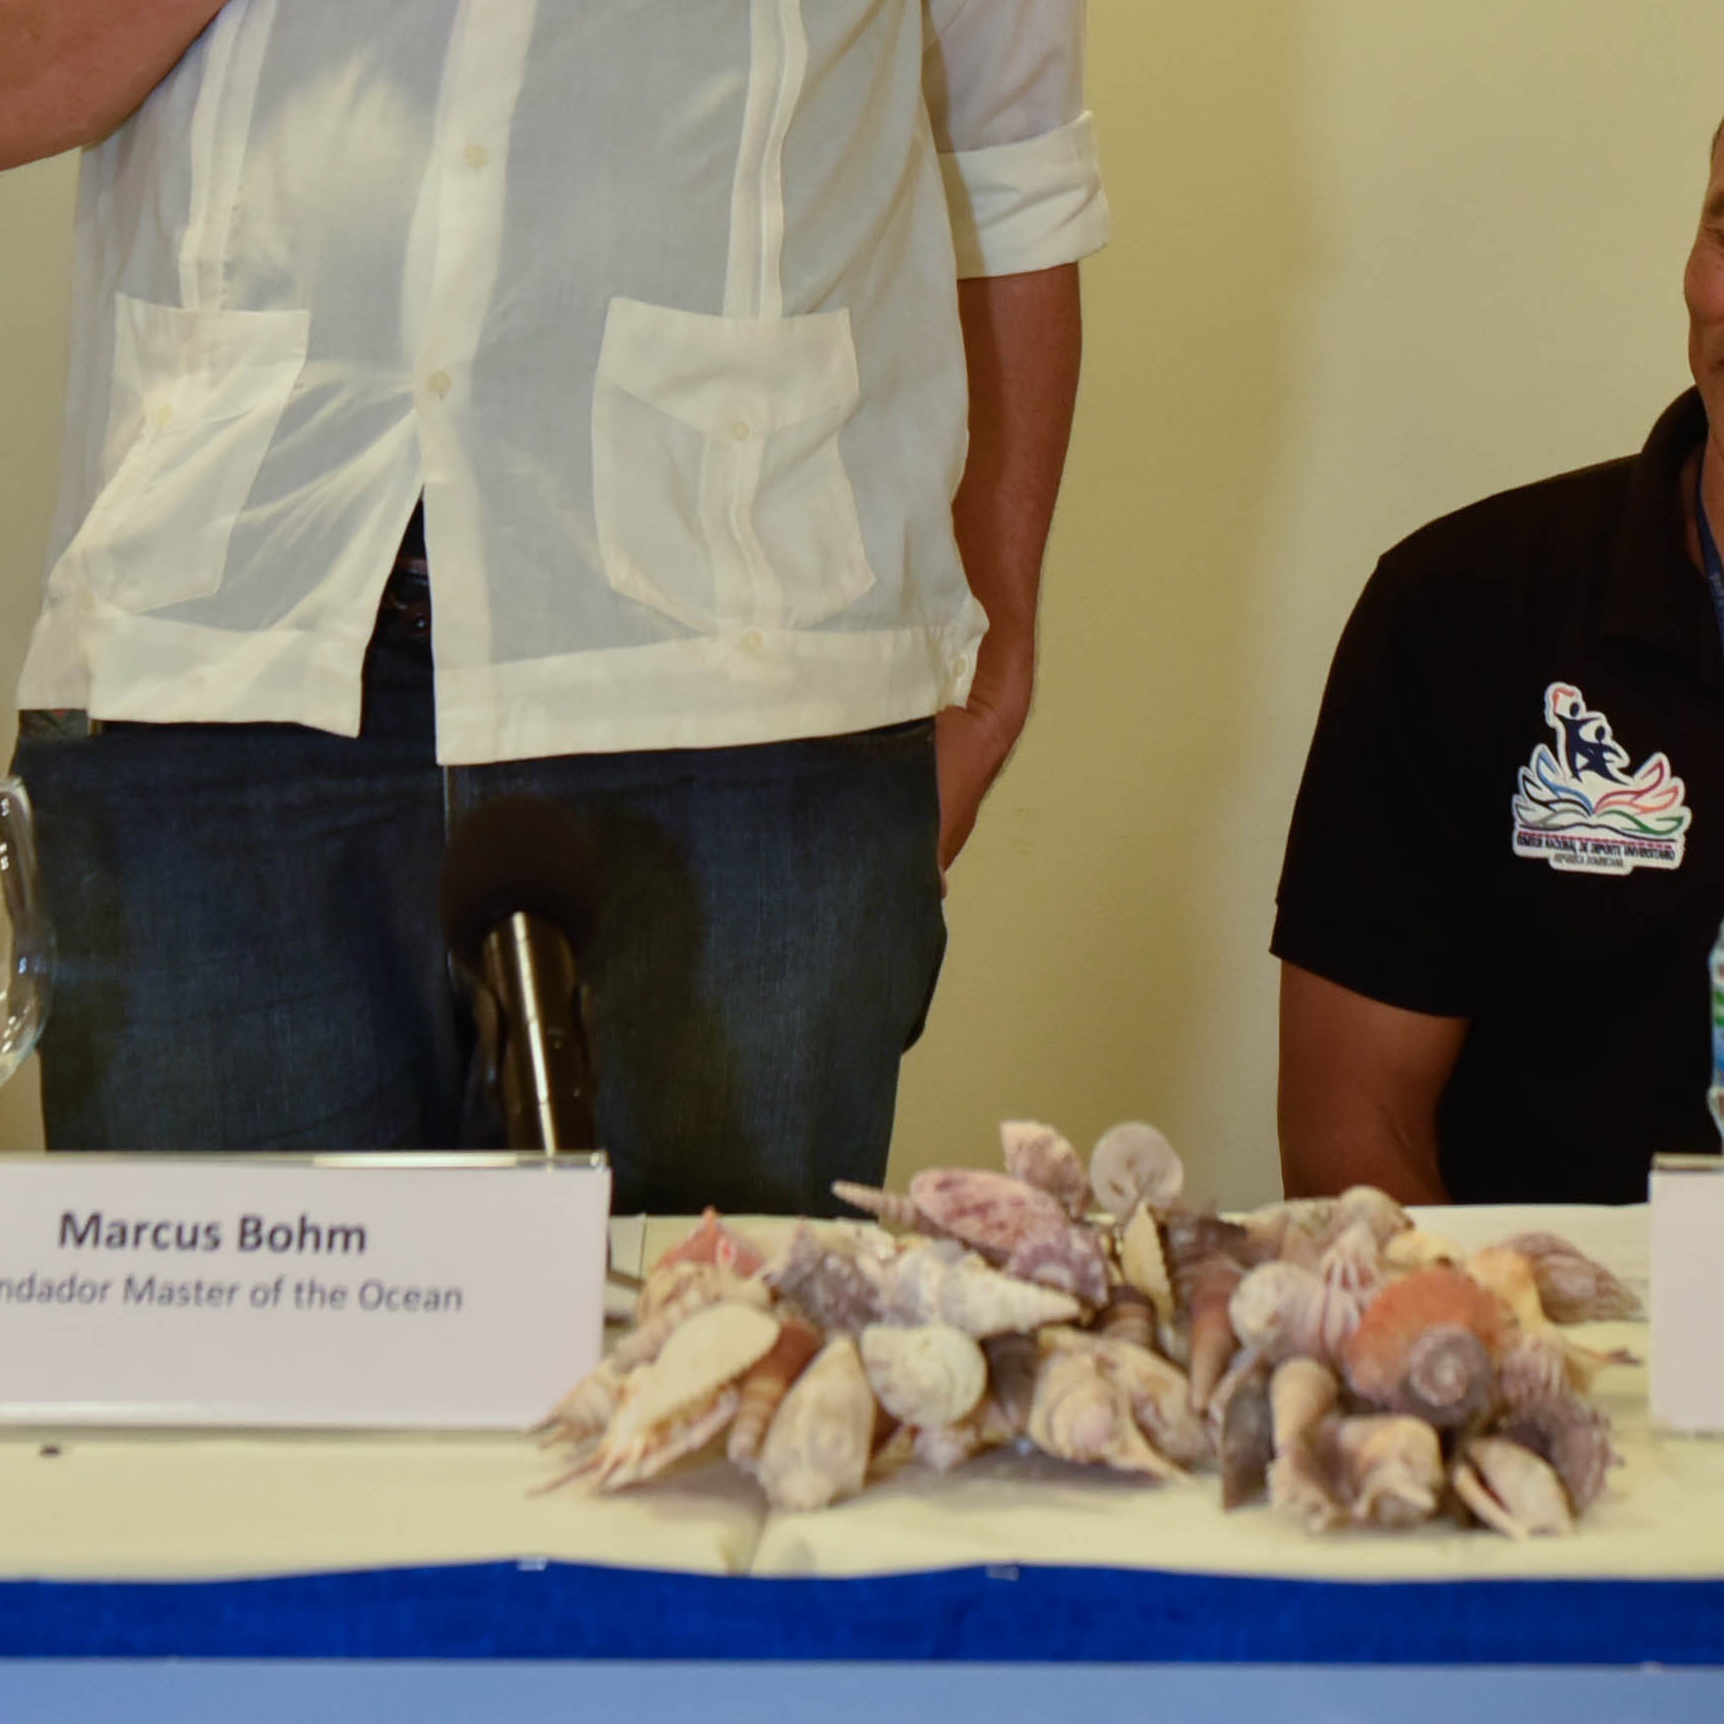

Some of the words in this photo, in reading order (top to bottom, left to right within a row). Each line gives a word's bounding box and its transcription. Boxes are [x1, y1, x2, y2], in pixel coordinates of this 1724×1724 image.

[58, 1211, 223, 1253] Marcus
[237, 1214, 367, 1256] Bohm
[124, 1274, 240, 1309] Master
[250, 1276, 284, 1310] of
[294, 1278, 348, 1311] the
[359, 1280, 463, 1313] Ocean
